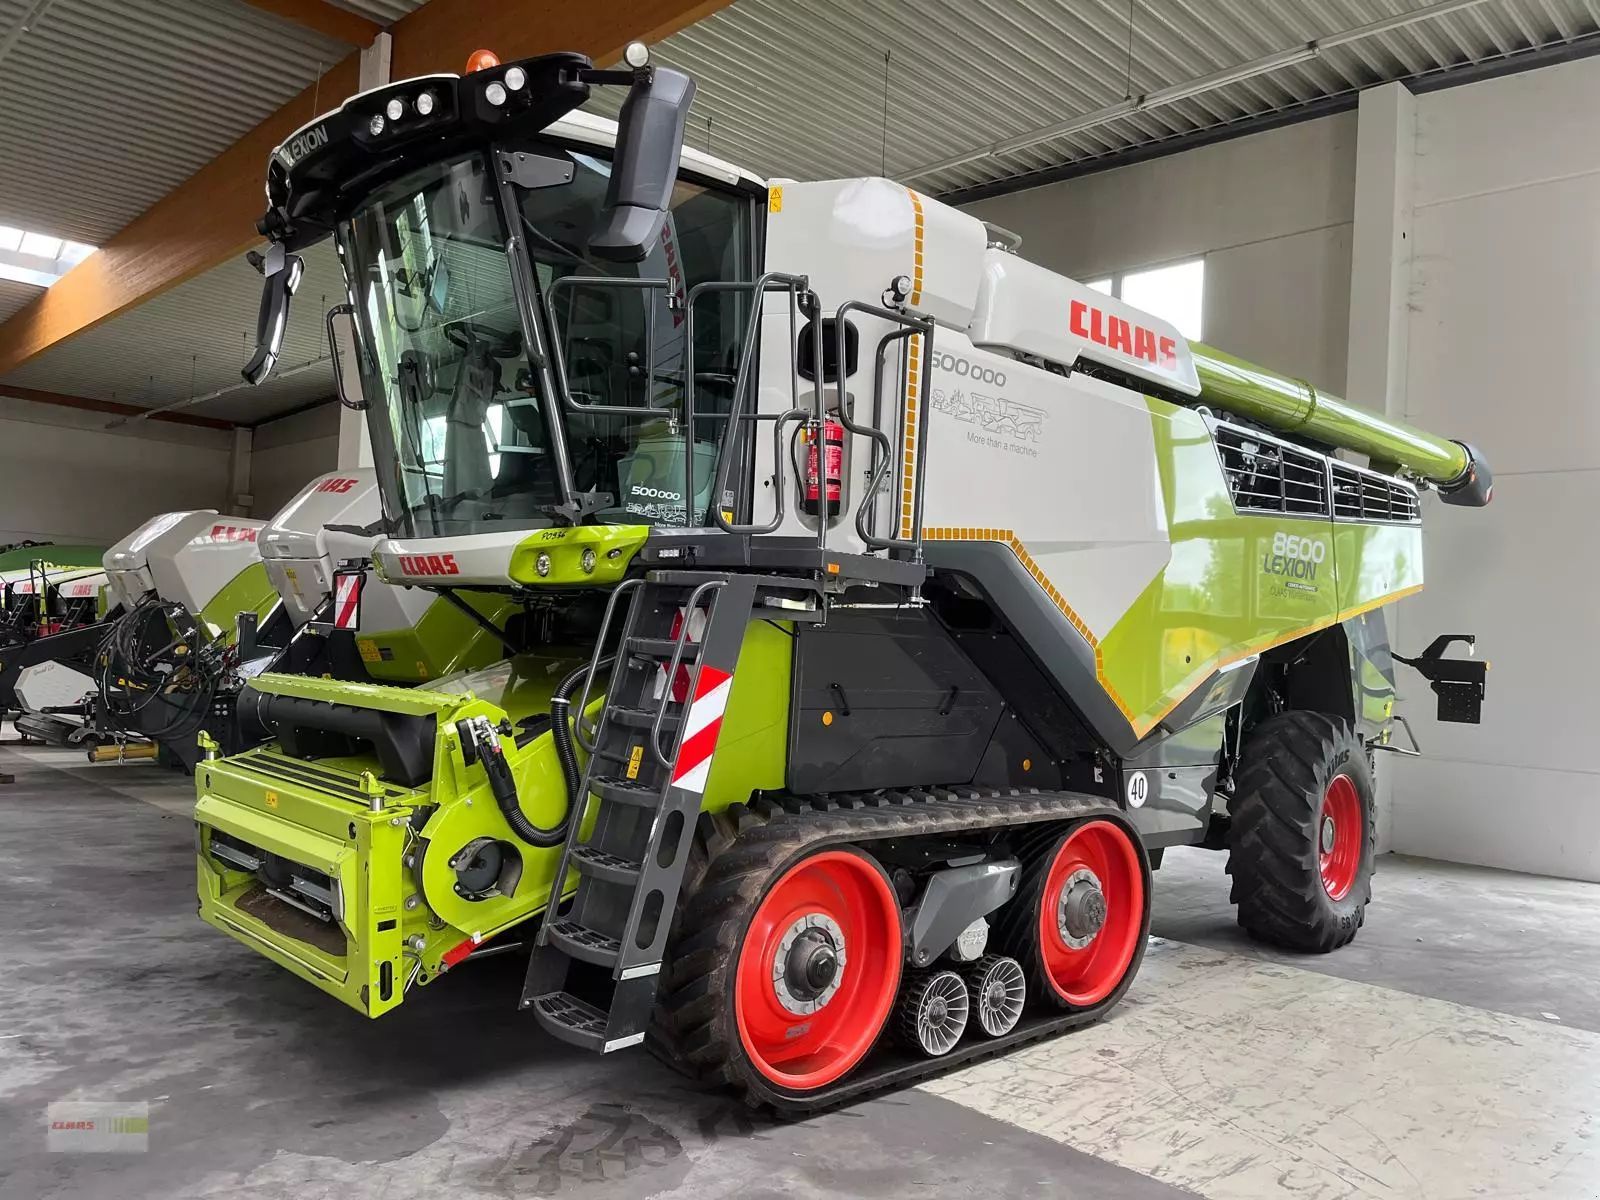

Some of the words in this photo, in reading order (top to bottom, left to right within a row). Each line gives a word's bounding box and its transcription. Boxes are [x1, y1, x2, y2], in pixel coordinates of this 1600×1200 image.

[1069, 299, 1177, 371] CLAAS
[970, 364, 1007, 388] 000
[966, 431, 986, 446] More
[987, 436, 1002, 449] than
[1003, 442, 1008, 450] a
[1009, 444, 1038, 458] machine
[314, 478, 360, 493] AAS
[630, 484, 658, 497] 500
[657, 490, 681, 501] 000
[211, 525, 257, 543] CLA
[1272, 530, 1326, 564] 8600
[398, 552, 460, 576] CLAAS
[1263, 552, 1318, 581] LEXION
[1131, 777, 1145, 800] 40
